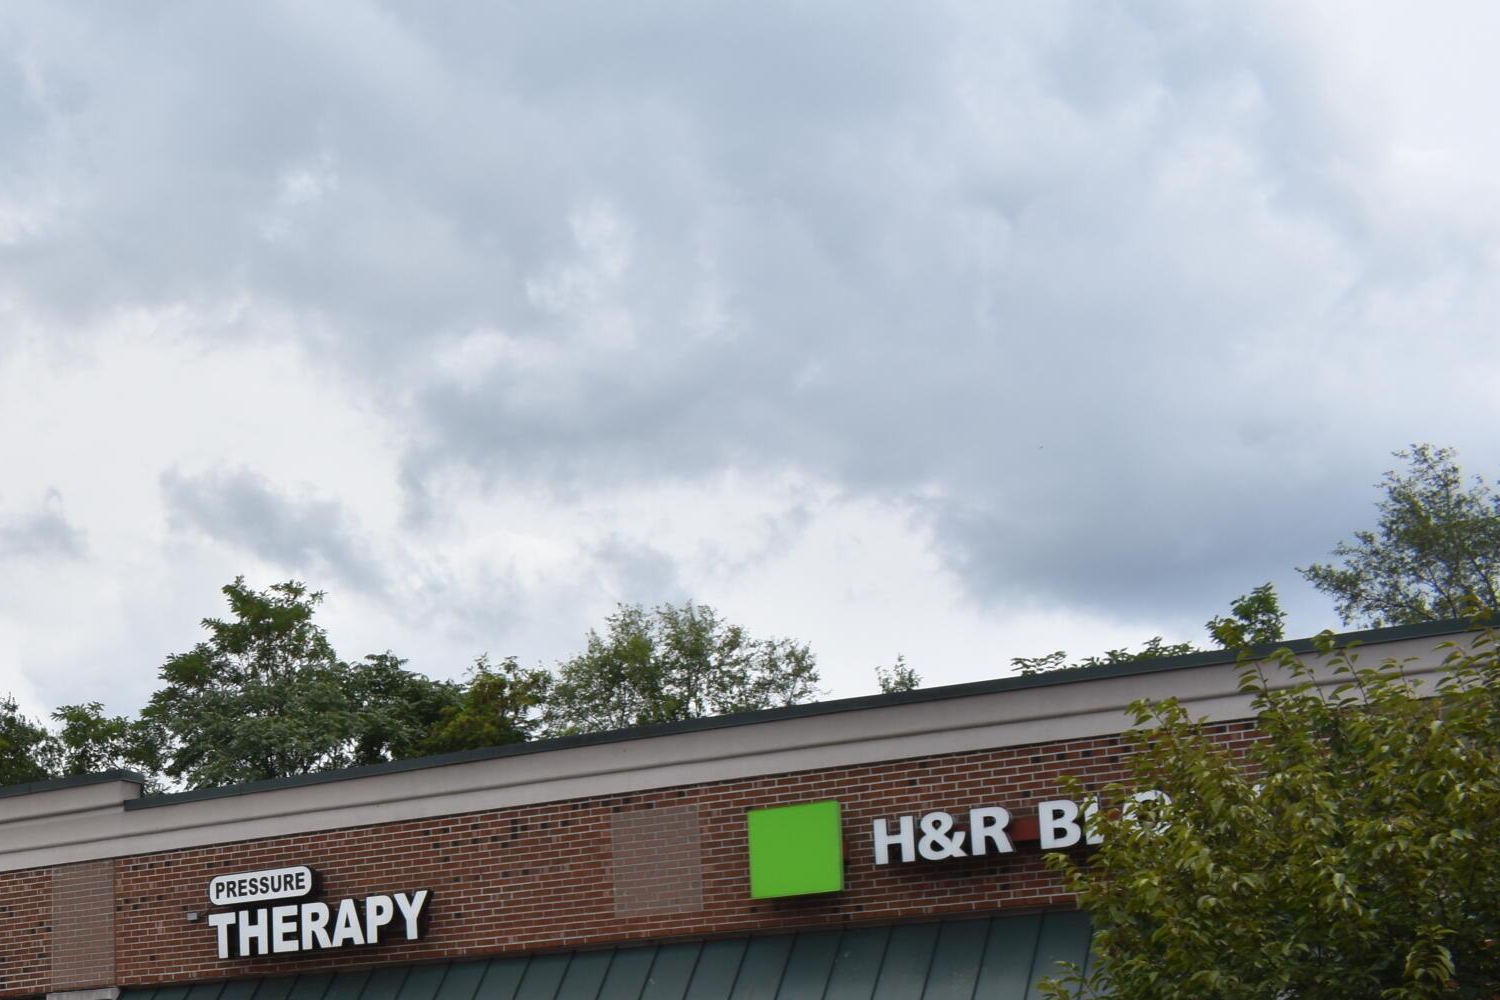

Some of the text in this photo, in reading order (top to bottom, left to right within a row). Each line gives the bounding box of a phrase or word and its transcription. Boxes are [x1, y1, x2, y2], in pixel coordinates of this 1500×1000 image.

[873, 806, 1013, 865] H&R
[215, 872, 305, 899] PRESSURE
[208, 890, 428, 959] THERAPY
